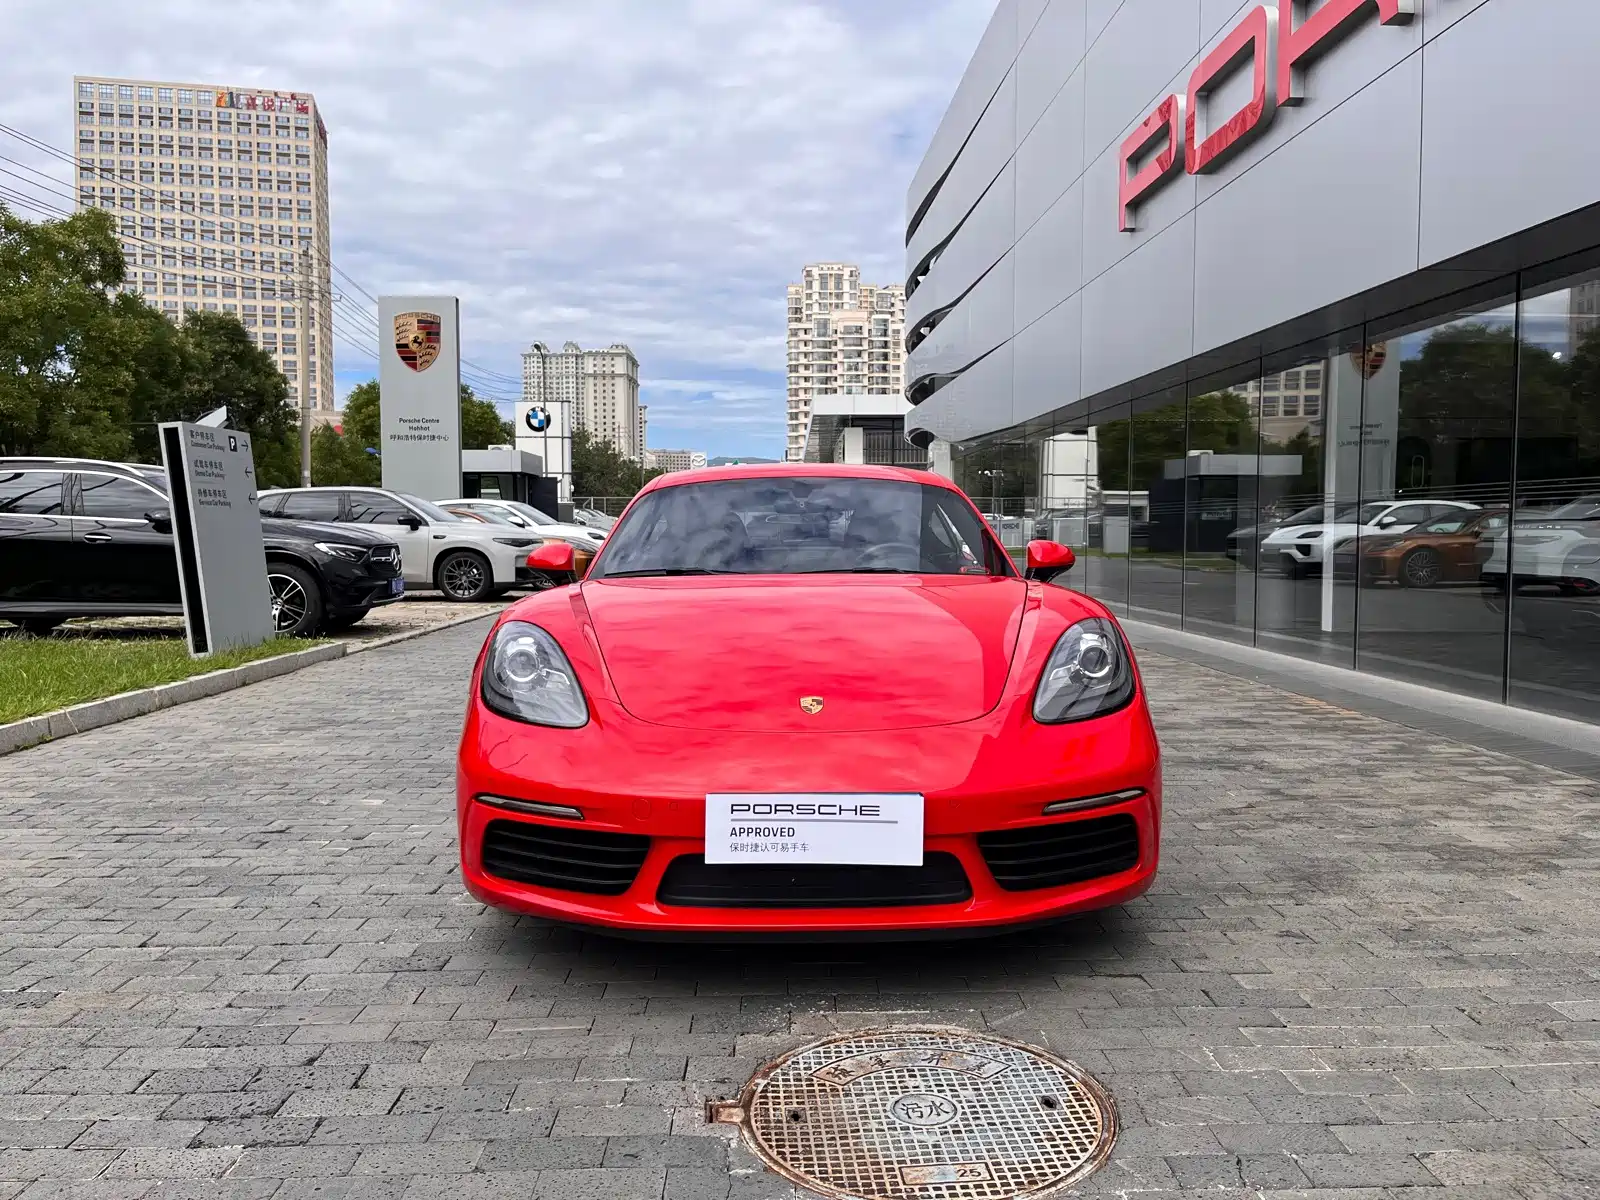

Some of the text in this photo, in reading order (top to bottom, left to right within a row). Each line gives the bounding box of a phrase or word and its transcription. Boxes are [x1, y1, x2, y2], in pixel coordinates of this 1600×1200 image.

[730, 803, 881, 817] PORSCHE
[729, 826, 796, 838] APPROVED
[729, 842, 810, 853] 保时捷认可易手车
[899, 1100, 950, 1120] 污水
[956, 1168, 982, 1178] 25
